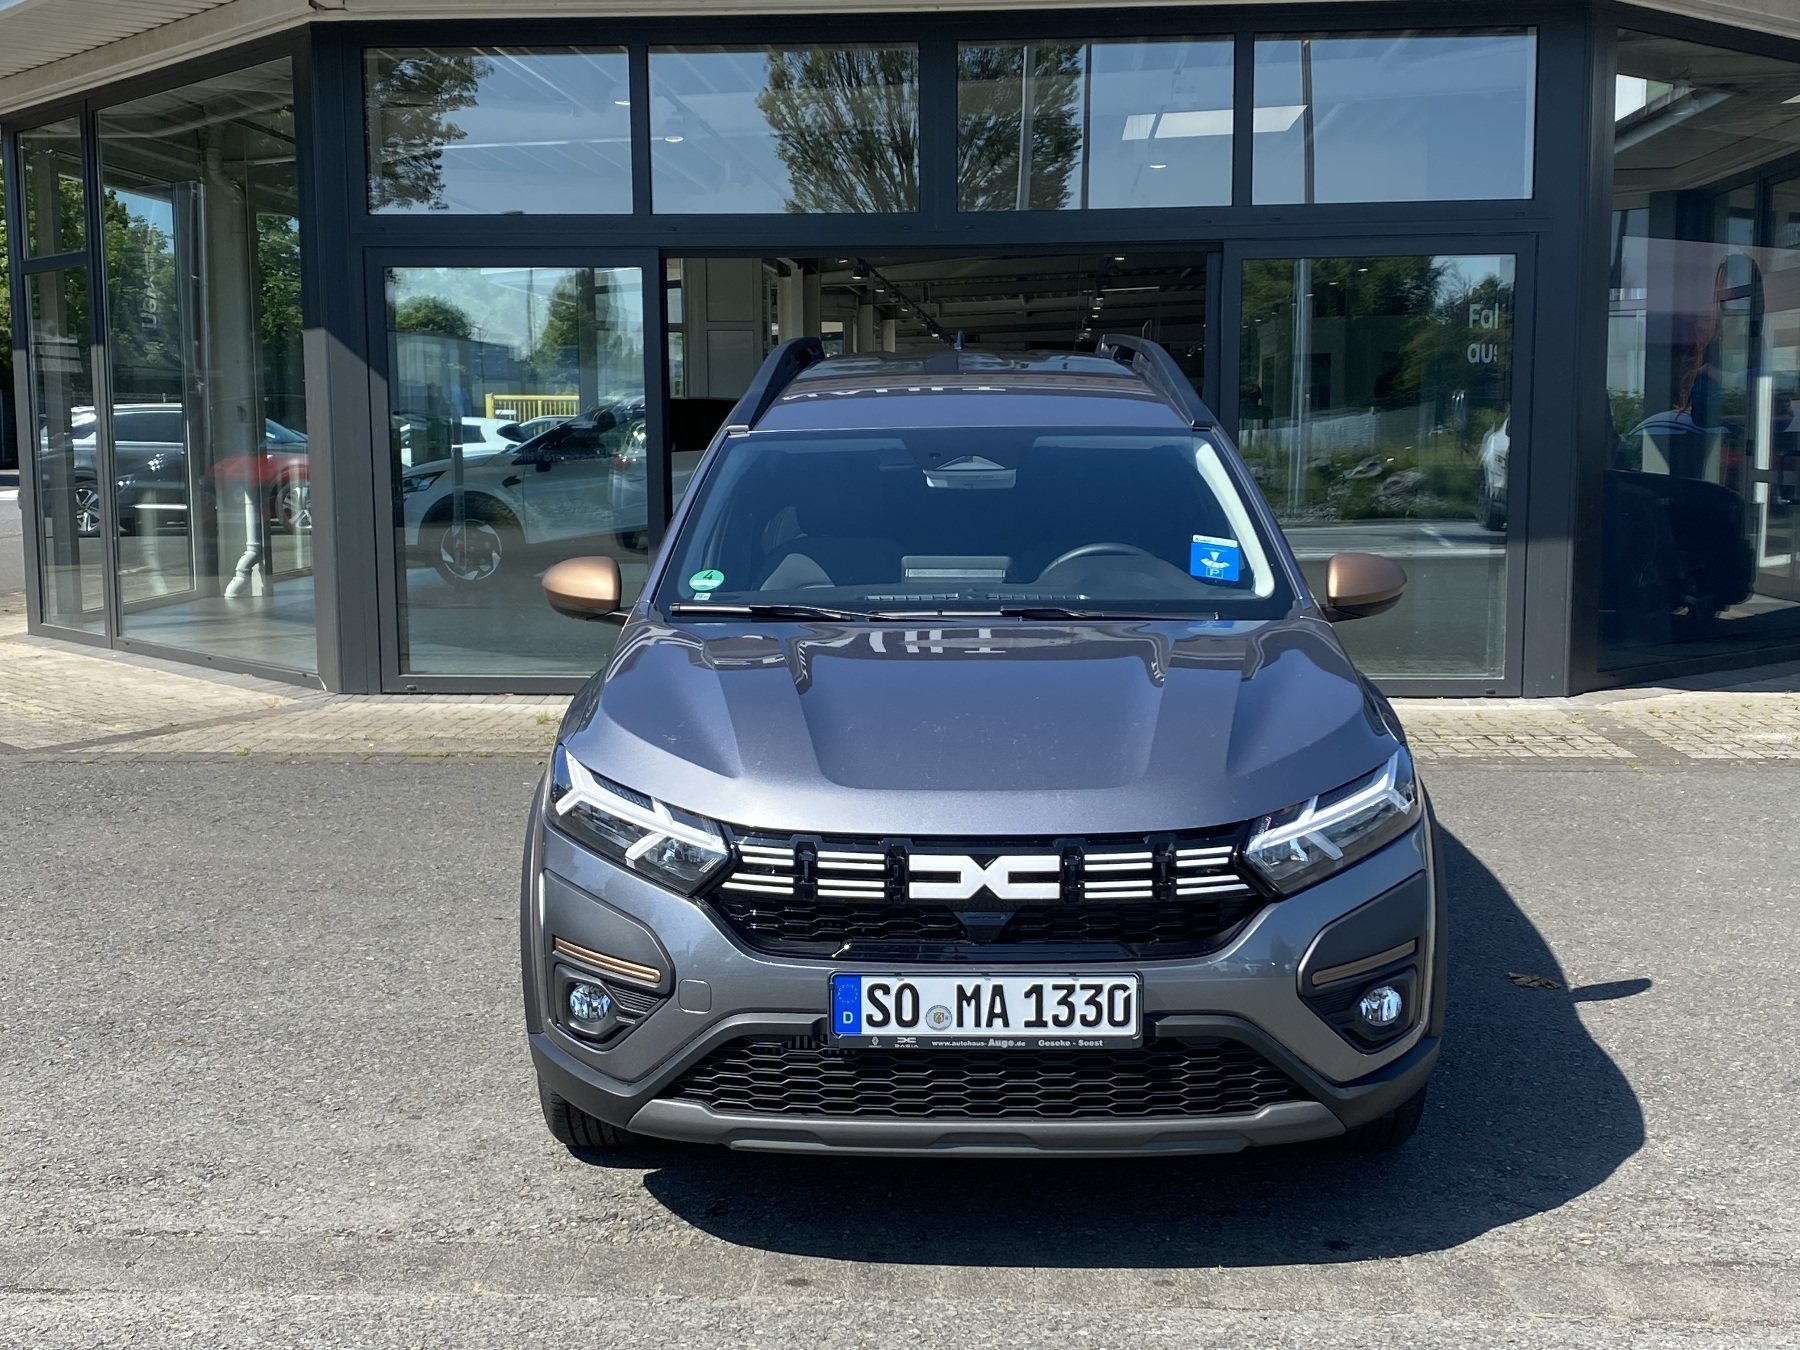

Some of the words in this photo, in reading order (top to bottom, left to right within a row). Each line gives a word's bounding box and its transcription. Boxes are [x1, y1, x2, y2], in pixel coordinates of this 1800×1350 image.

[703, 570, 714, 580] 4
[866, 983, 920, 1028] SO
[956, 984, 1010, 1028] MA
[1024, 984, 1131, 1028] 1330
[842, 1011, 853, 1024] D
[1078, 1039, 1104, 1047] Soest
